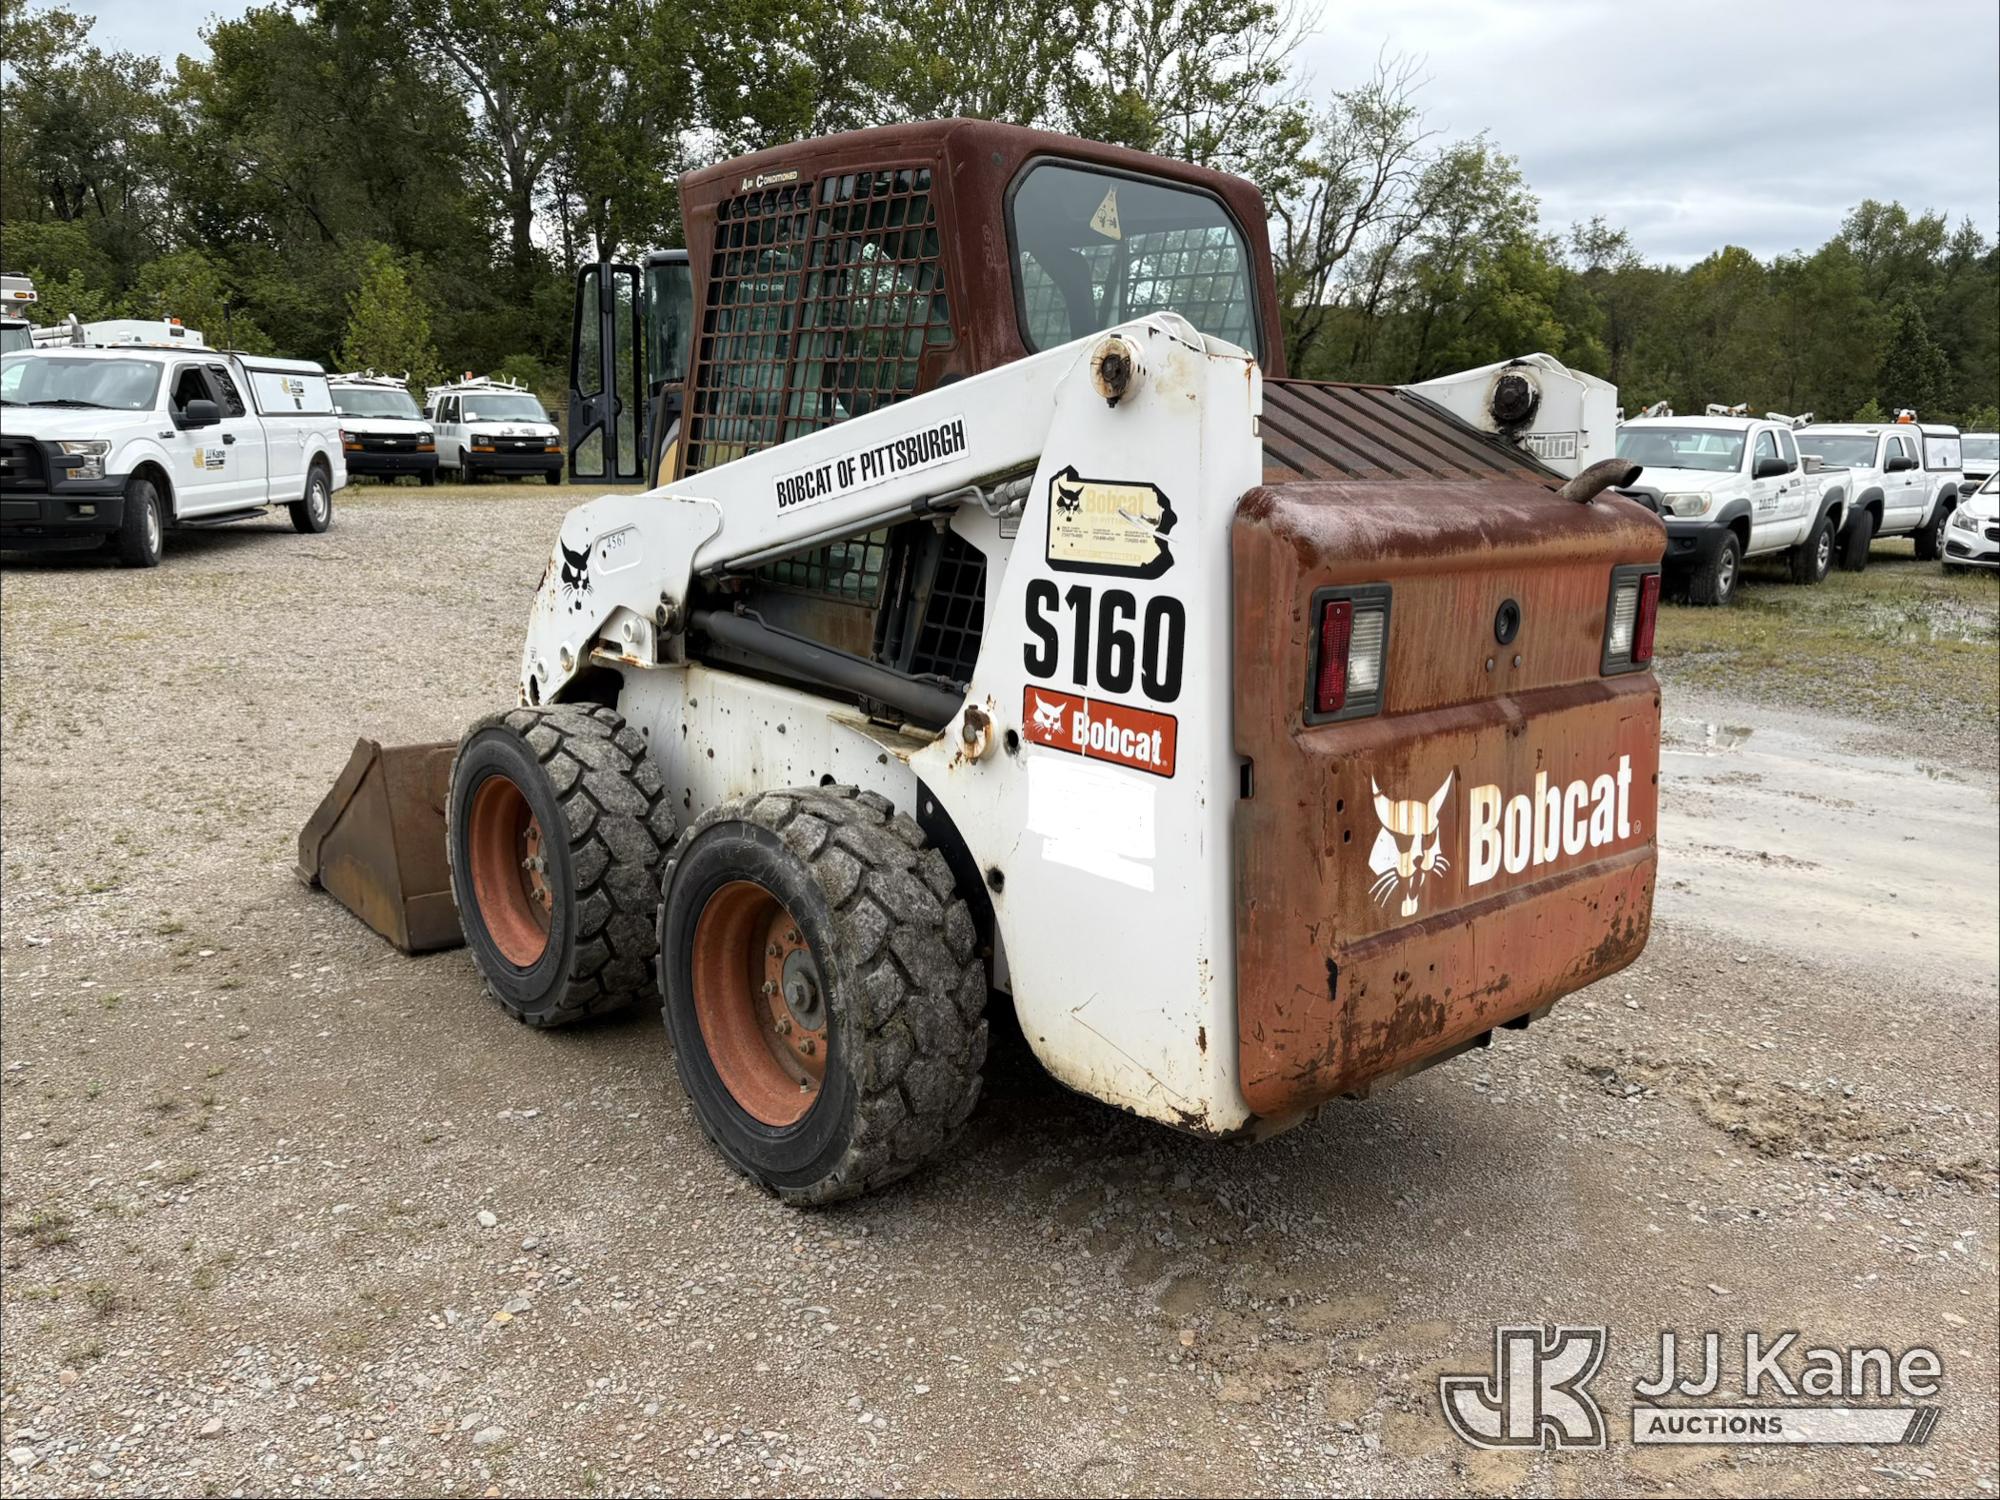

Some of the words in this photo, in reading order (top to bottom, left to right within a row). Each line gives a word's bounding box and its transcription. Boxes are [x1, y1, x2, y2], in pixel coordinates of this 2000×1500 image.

[776, 465, 832, 508] BOBCAT
[836, 457, 856, 489] OF
[860, 419, 966, 481] PITTSBURGH
[1023, 578, 1186, 703] S160
[1072, 710, 1162, 766] Bobcat
[1468, 754, 1632, 886] Bobcat
